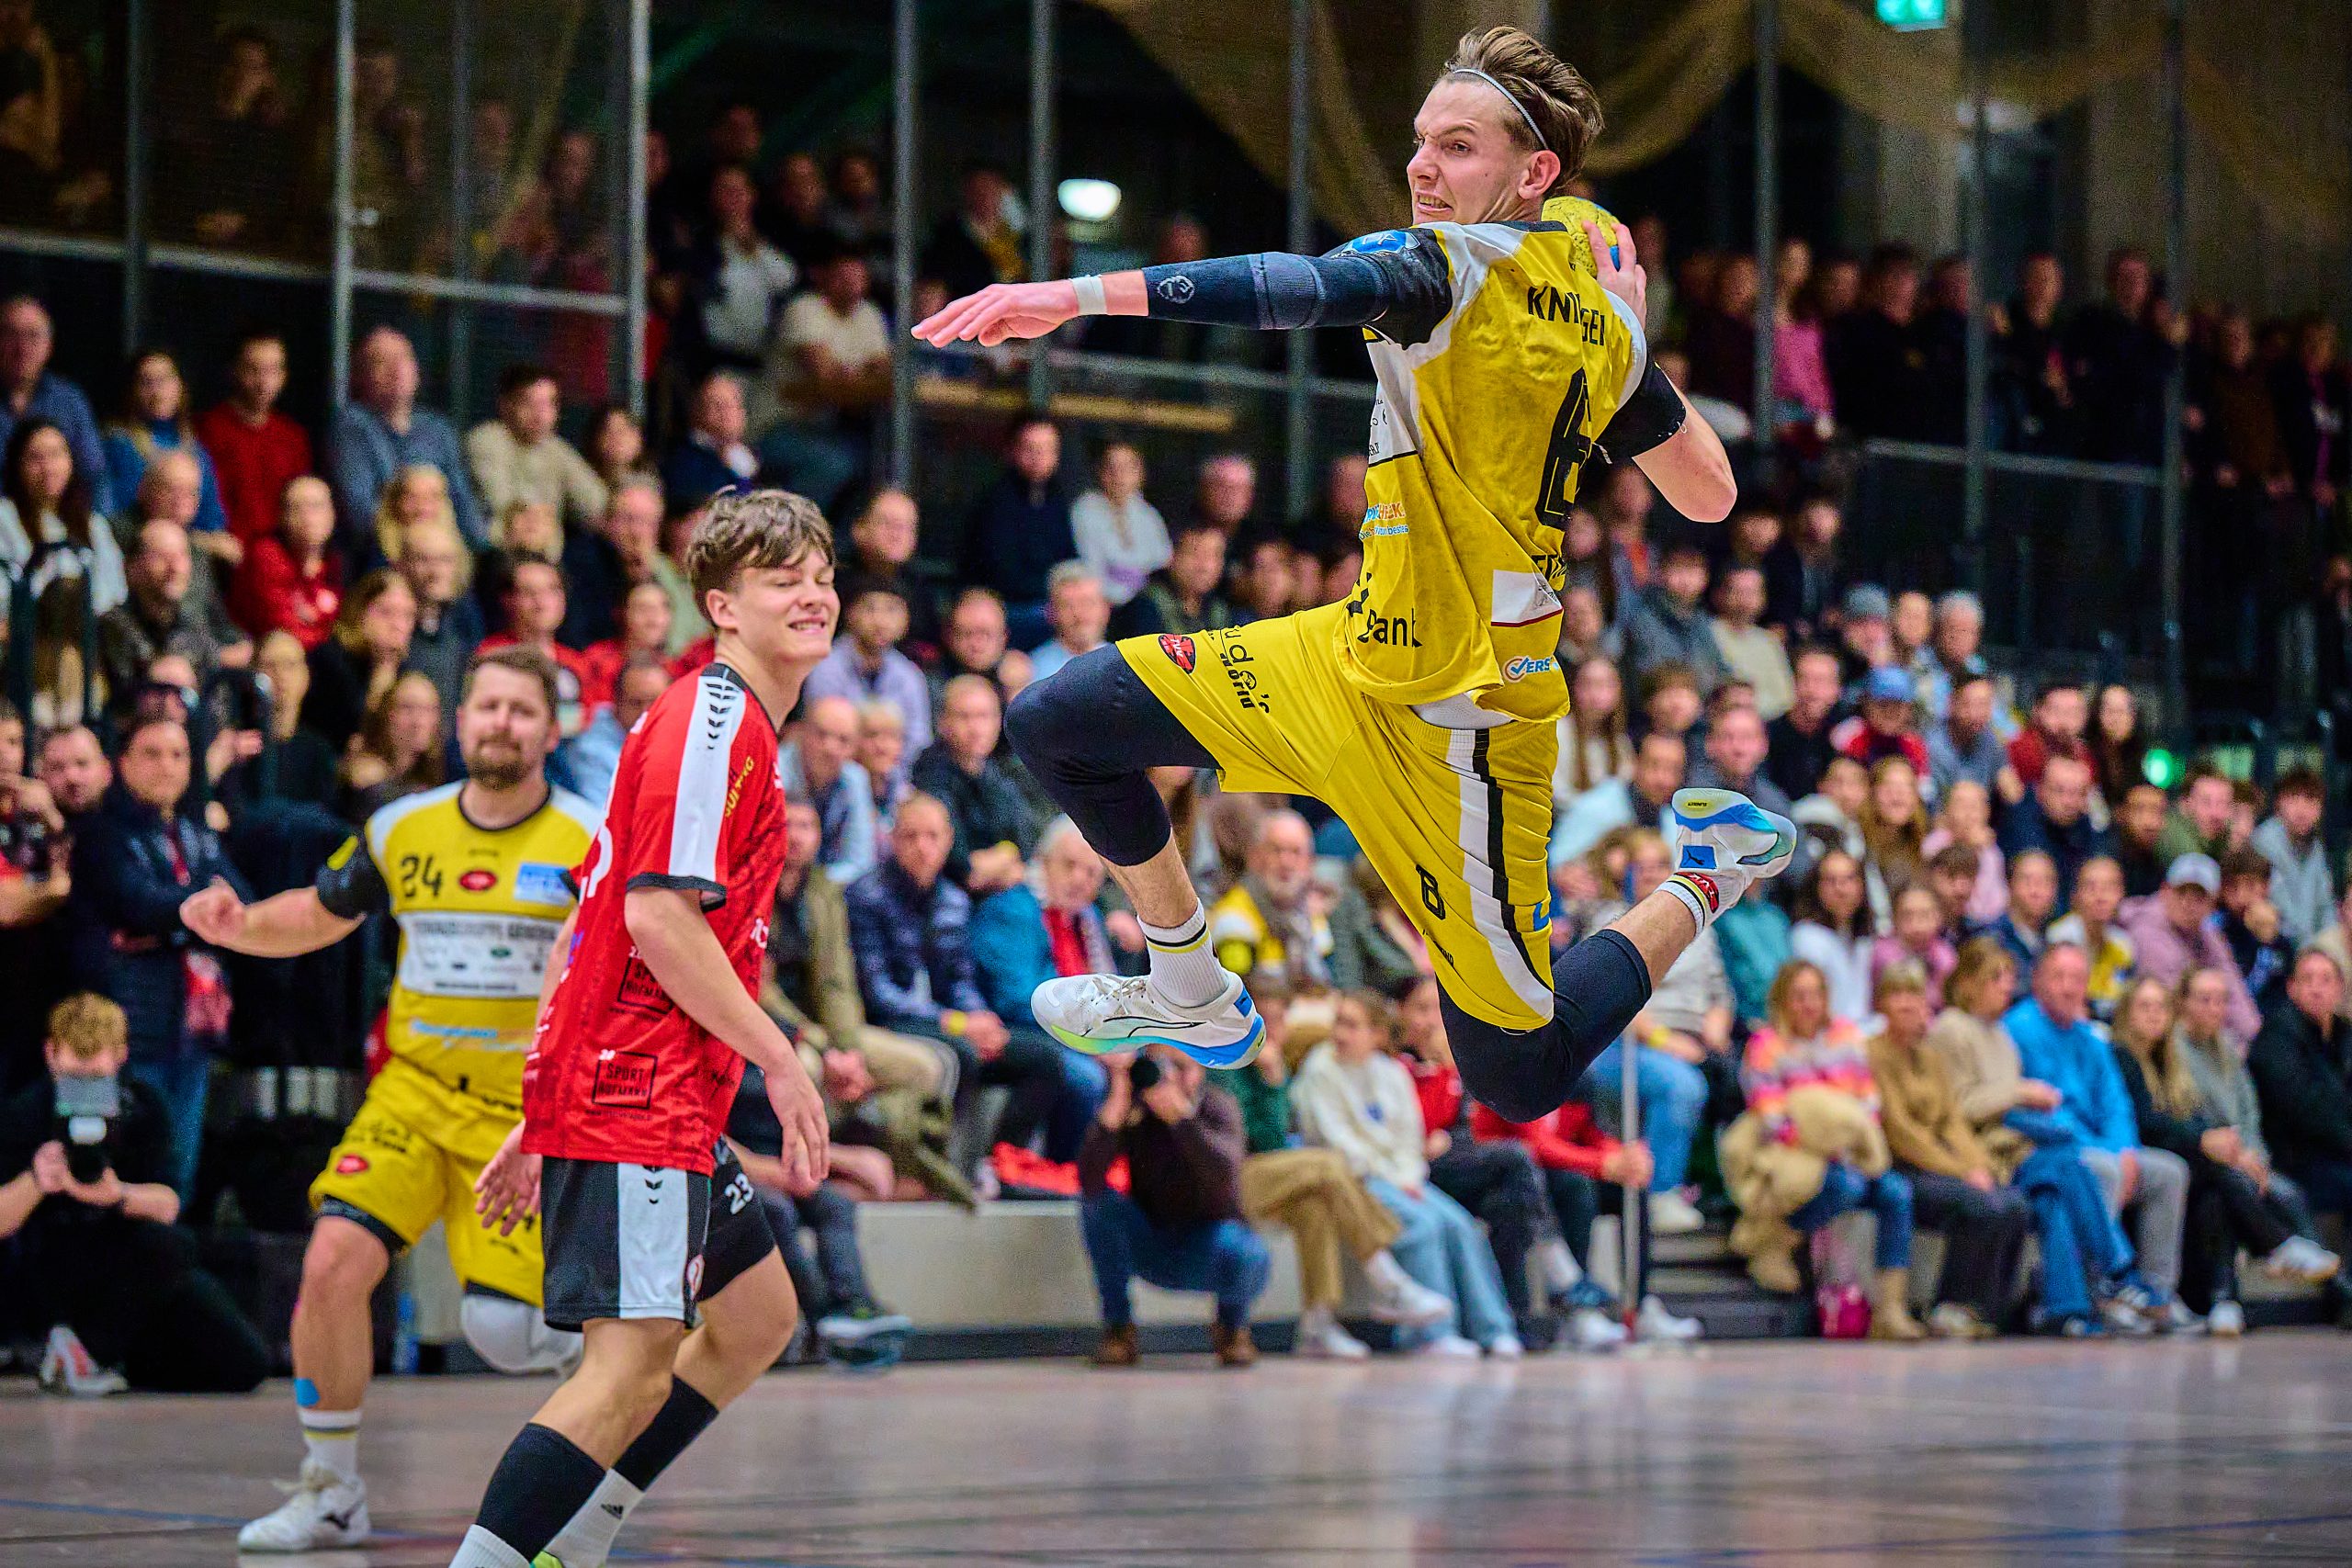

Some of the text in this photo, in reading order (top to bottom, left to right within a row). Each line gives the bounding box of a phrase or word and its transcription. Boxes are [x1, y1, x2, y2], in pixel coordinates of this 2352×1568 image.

[401, 853, 442, 898] 24
[606, 1062, 645, 1083] SPORT
[724, 1172, 754, 1215] 23
